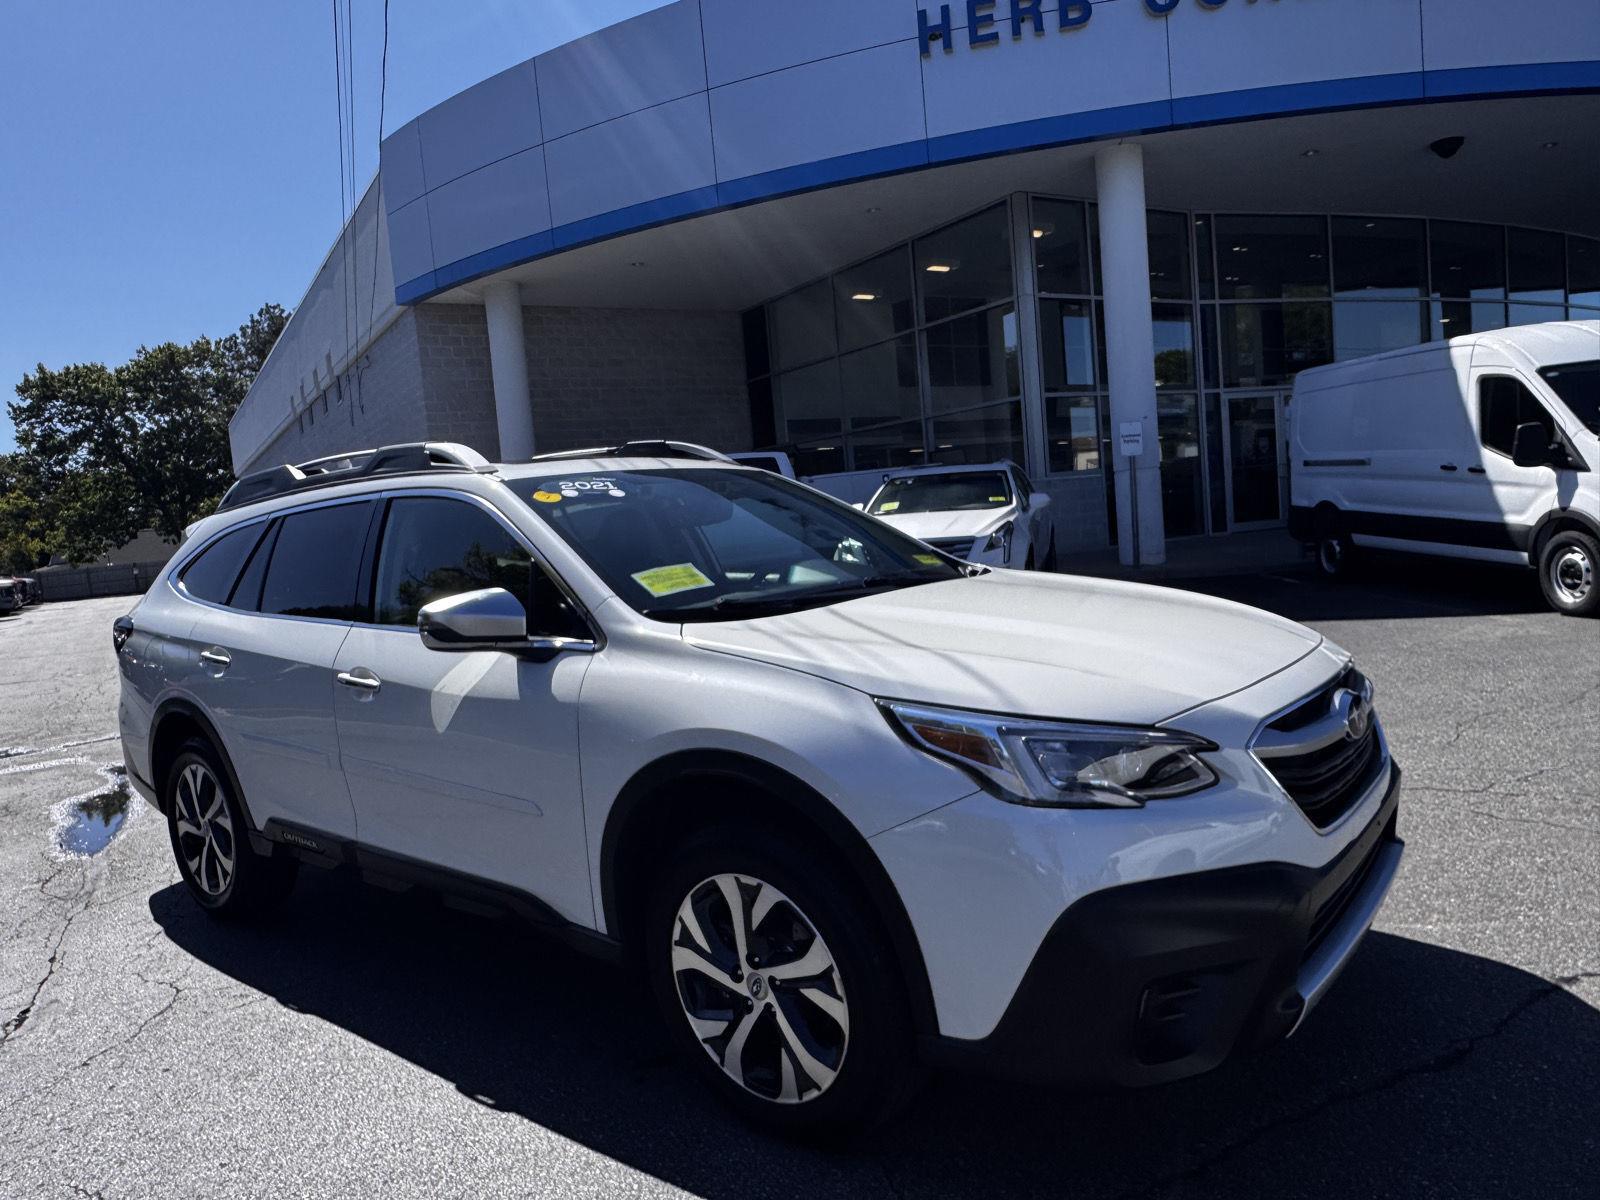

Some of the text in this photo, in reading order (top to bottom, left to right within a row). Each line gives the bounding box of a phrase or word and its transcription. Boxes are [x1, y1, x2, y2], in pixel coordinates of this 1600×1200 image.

[917, 0, 1093, 56] HERB
[558, 481, 618, 490] 2021
[283, 831, 321, 849] OUTBACK
